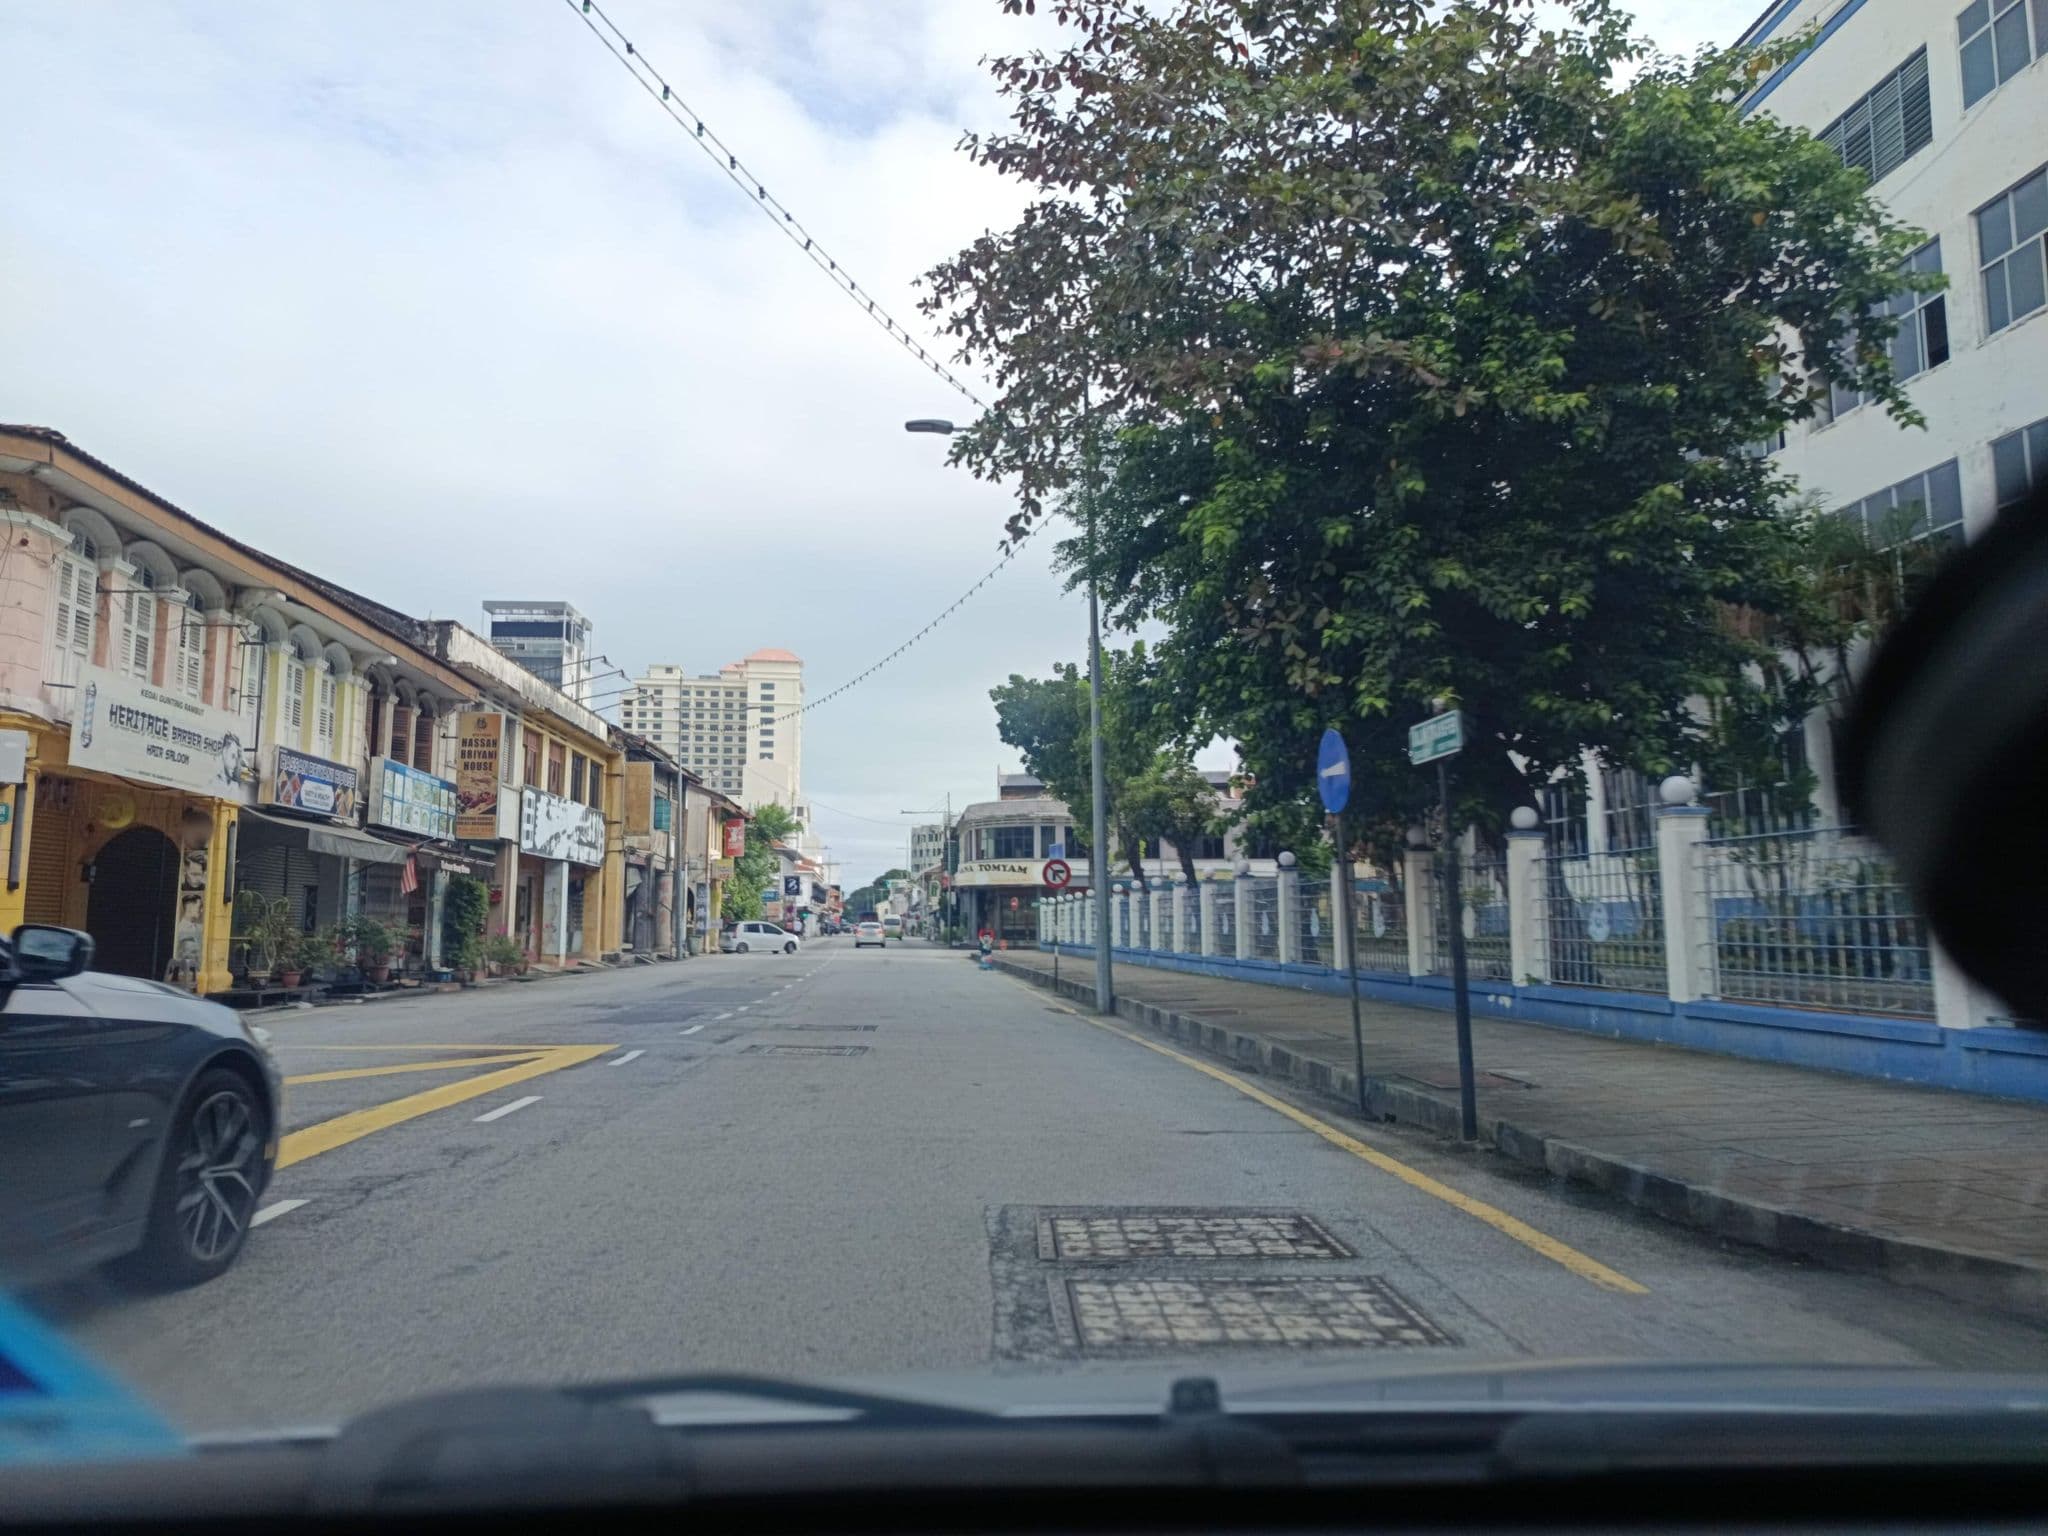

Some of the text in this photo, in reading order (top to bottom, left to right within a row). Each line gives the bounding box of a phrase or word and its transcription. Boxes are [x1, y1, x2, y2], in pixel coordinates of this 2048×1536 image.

[109, 704, 169, 738] HERITAGE
[172, 726, 202, 746] BARBER
[462, 737, 497, 748] HASSAN
[147, 744, 164, 759] HAIR
[461, 749, 497, 759] BRIYANI
[463, 761, 493, 771] HOUSE
[978, 863, 1028, 874] TOMYAM
